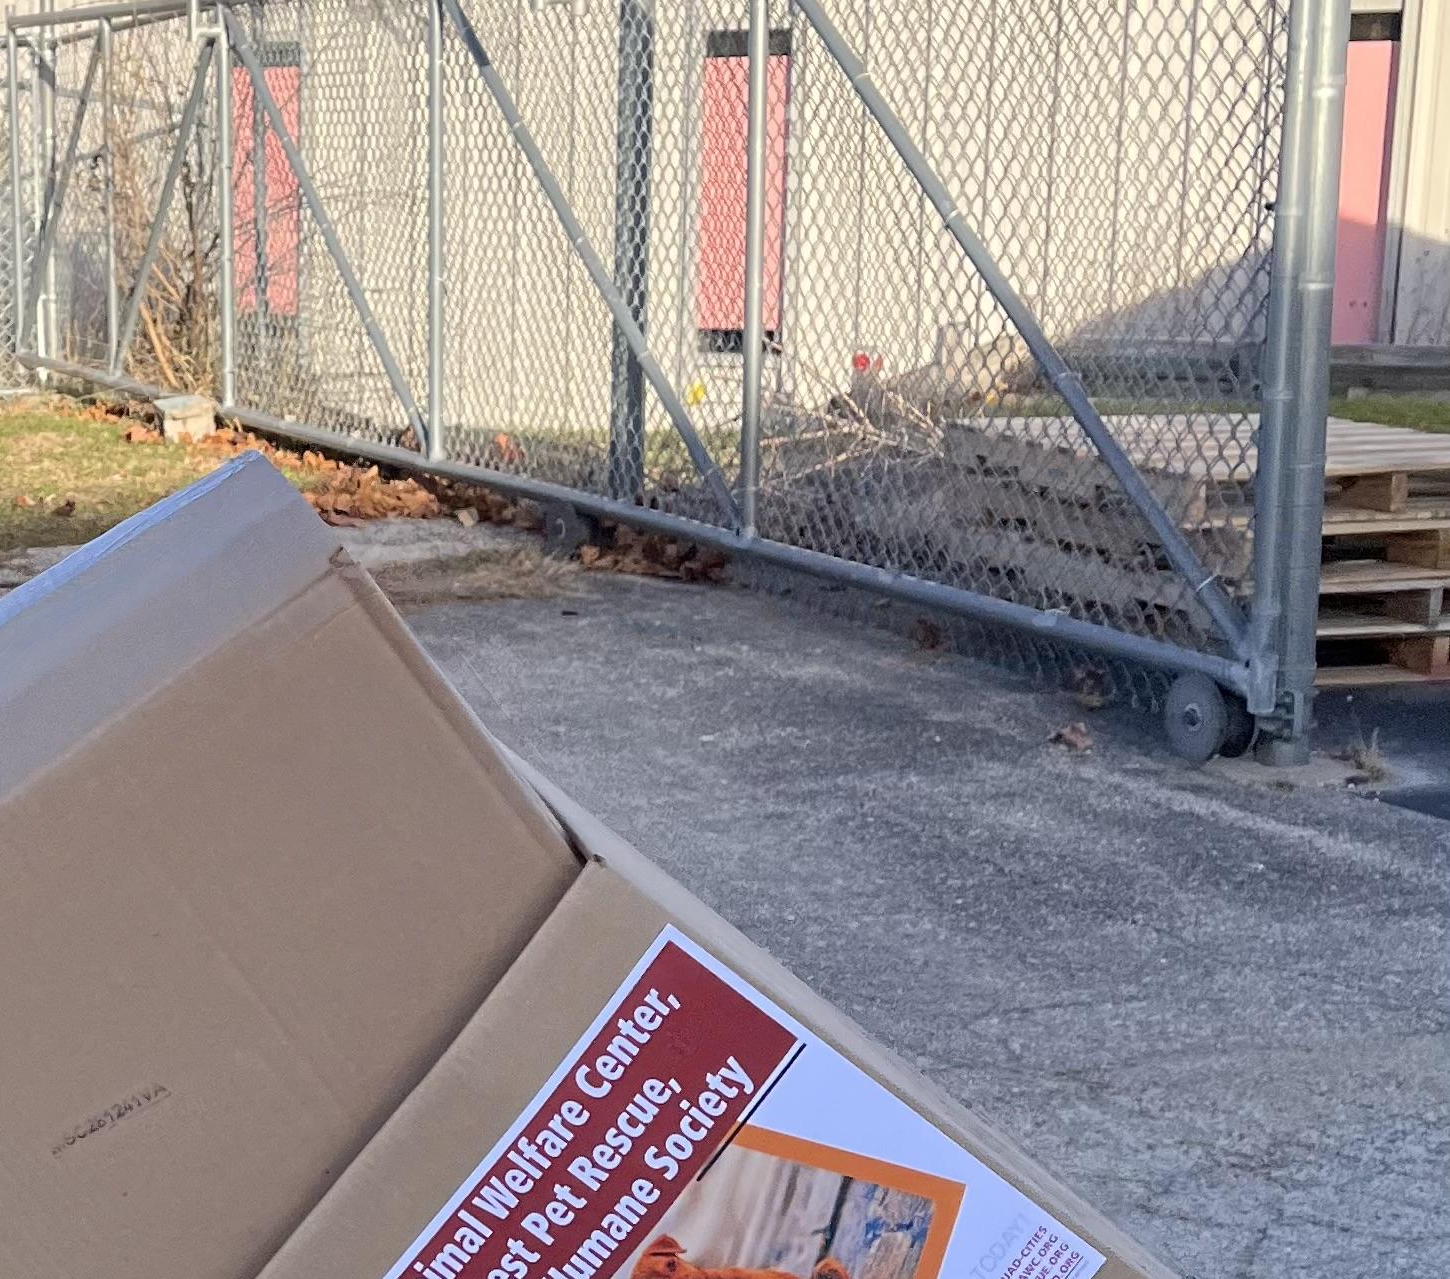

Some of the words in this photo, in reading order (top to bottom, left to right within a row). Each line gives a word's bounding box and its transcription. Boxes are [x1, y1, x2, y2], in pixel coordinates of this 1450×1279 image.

[471, 1100, 591, 1220] Welfare
[575, 988, 681, 1098] Center,
[520, 1183, 588, 1246] Pet
[566, 1077, 682, 1192] Rescue,
[644, 1055, 755, 1181] Society
